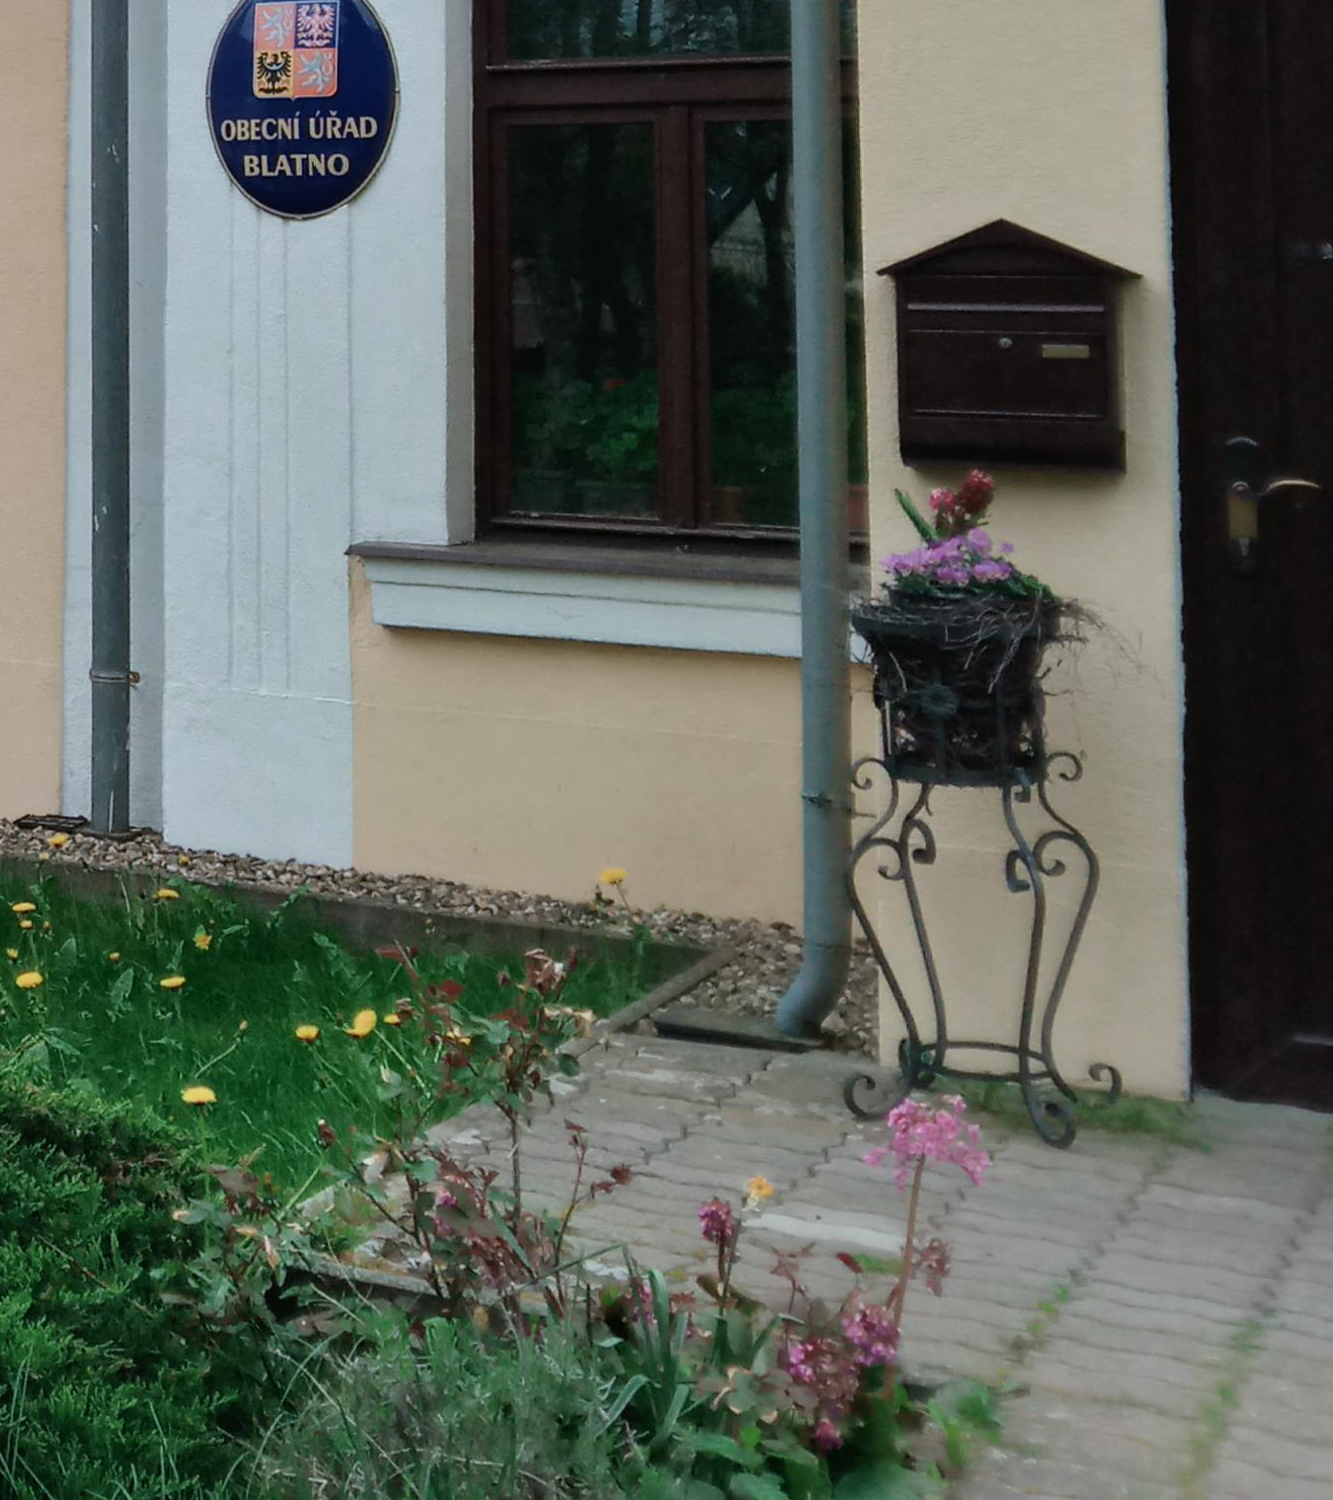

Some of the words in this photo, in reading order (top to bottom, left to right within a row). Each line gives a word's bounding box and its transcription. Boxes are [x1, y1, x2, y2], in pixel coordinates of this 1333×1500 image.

[221, 111, 300, 141] OBECNÍ
[309, 110, 378, 139] ÚŘAD
[244, 153, 350, 177] BLATNO
